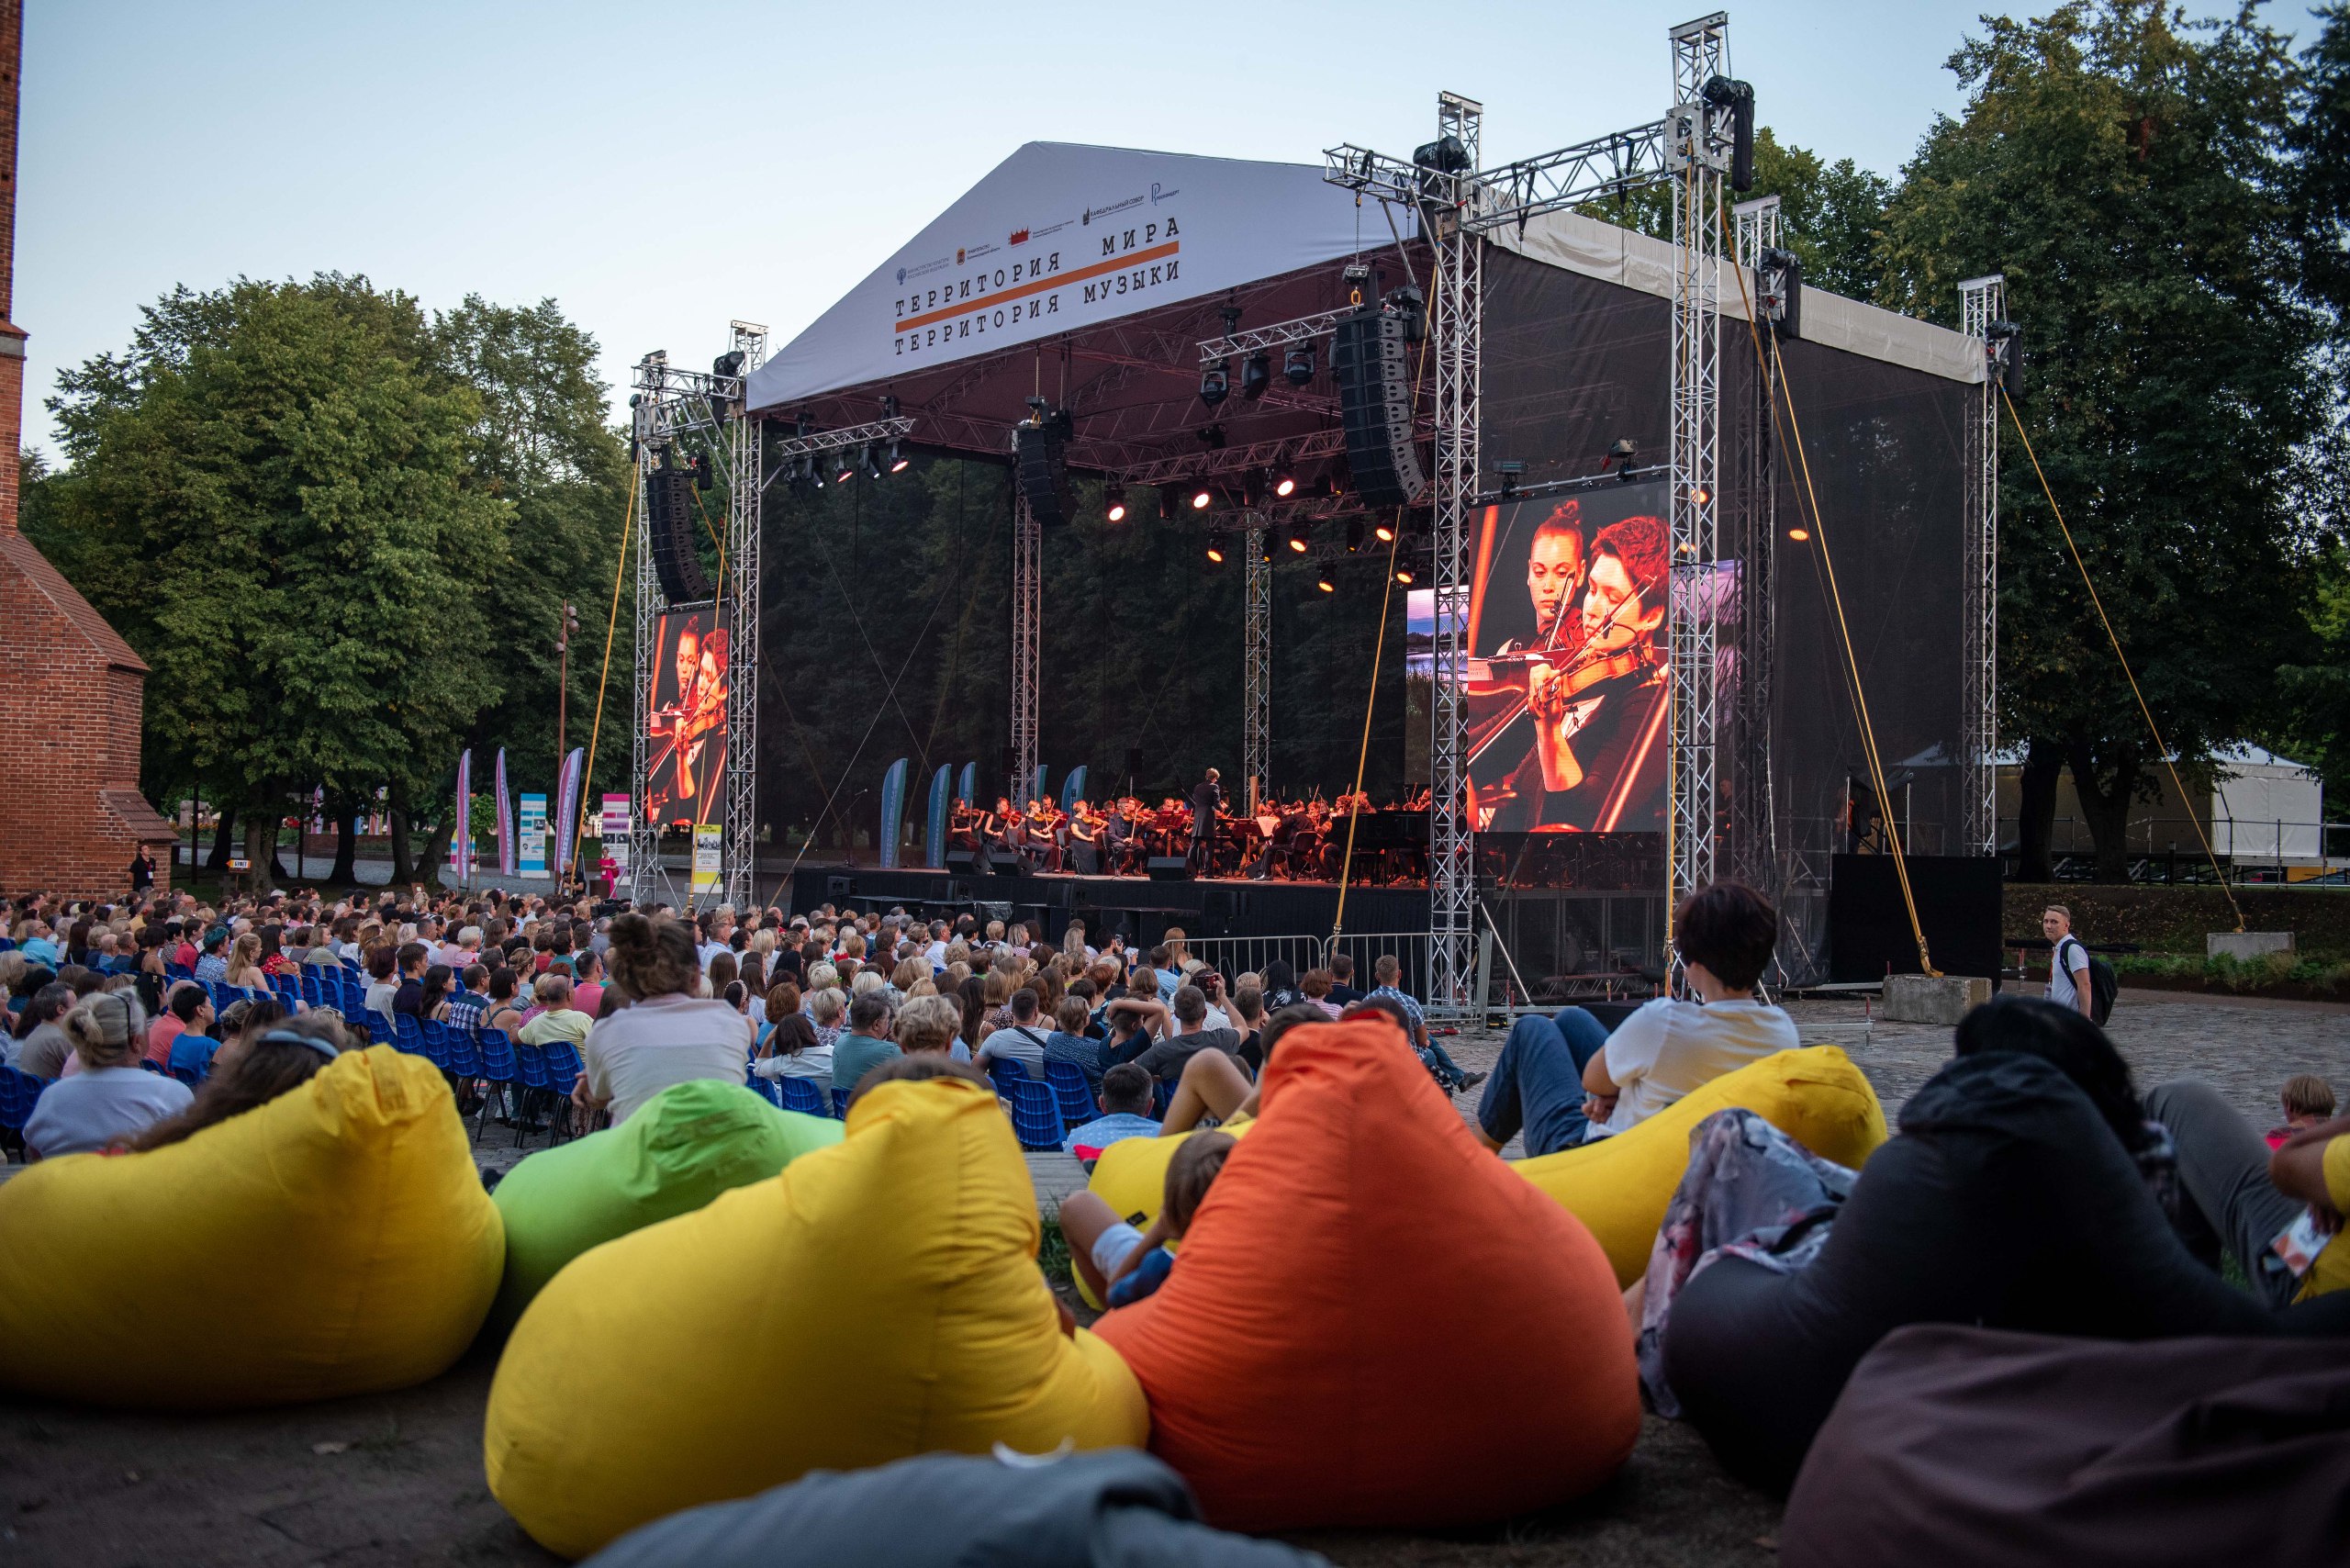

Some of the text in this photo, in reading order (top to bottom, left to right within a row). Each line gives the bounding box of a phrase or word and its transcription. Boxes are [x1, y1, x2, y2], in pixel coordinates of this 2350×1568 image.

[1091, 199, 1128, 217] КАФЕДРАЛЬНЫЙ
[1129, 195, 1145, 205] СОБОР
[894, 261, 1180, 356] ТЕРРИТОРИЯ МУЗЫКИ
[895, 217, 1180, 317] ТЕРРИТОРИЯ МИРА
